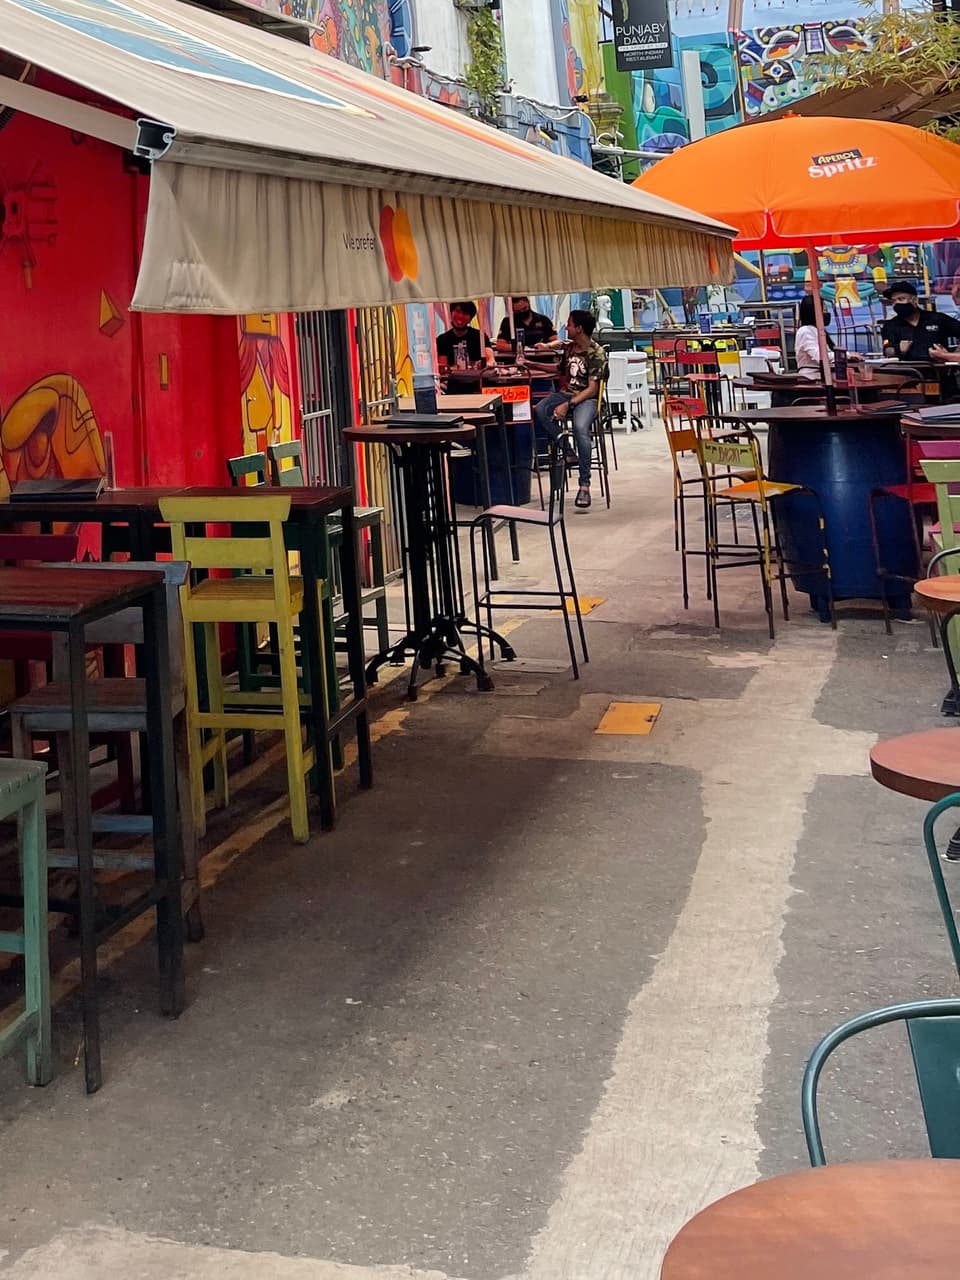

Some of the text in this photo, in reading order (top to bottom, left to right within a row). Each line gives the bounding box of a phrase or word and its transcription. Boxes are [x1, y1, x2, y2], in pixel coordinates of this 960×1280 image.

[616, 23, 666, 37] PUNJABY
[623, 34, 660, 45] DAWAT
[817, 150, 858, 165] APEROL
[808, 156, 878, 178] Spritz
[343, 232, 376, 250] We prefer
